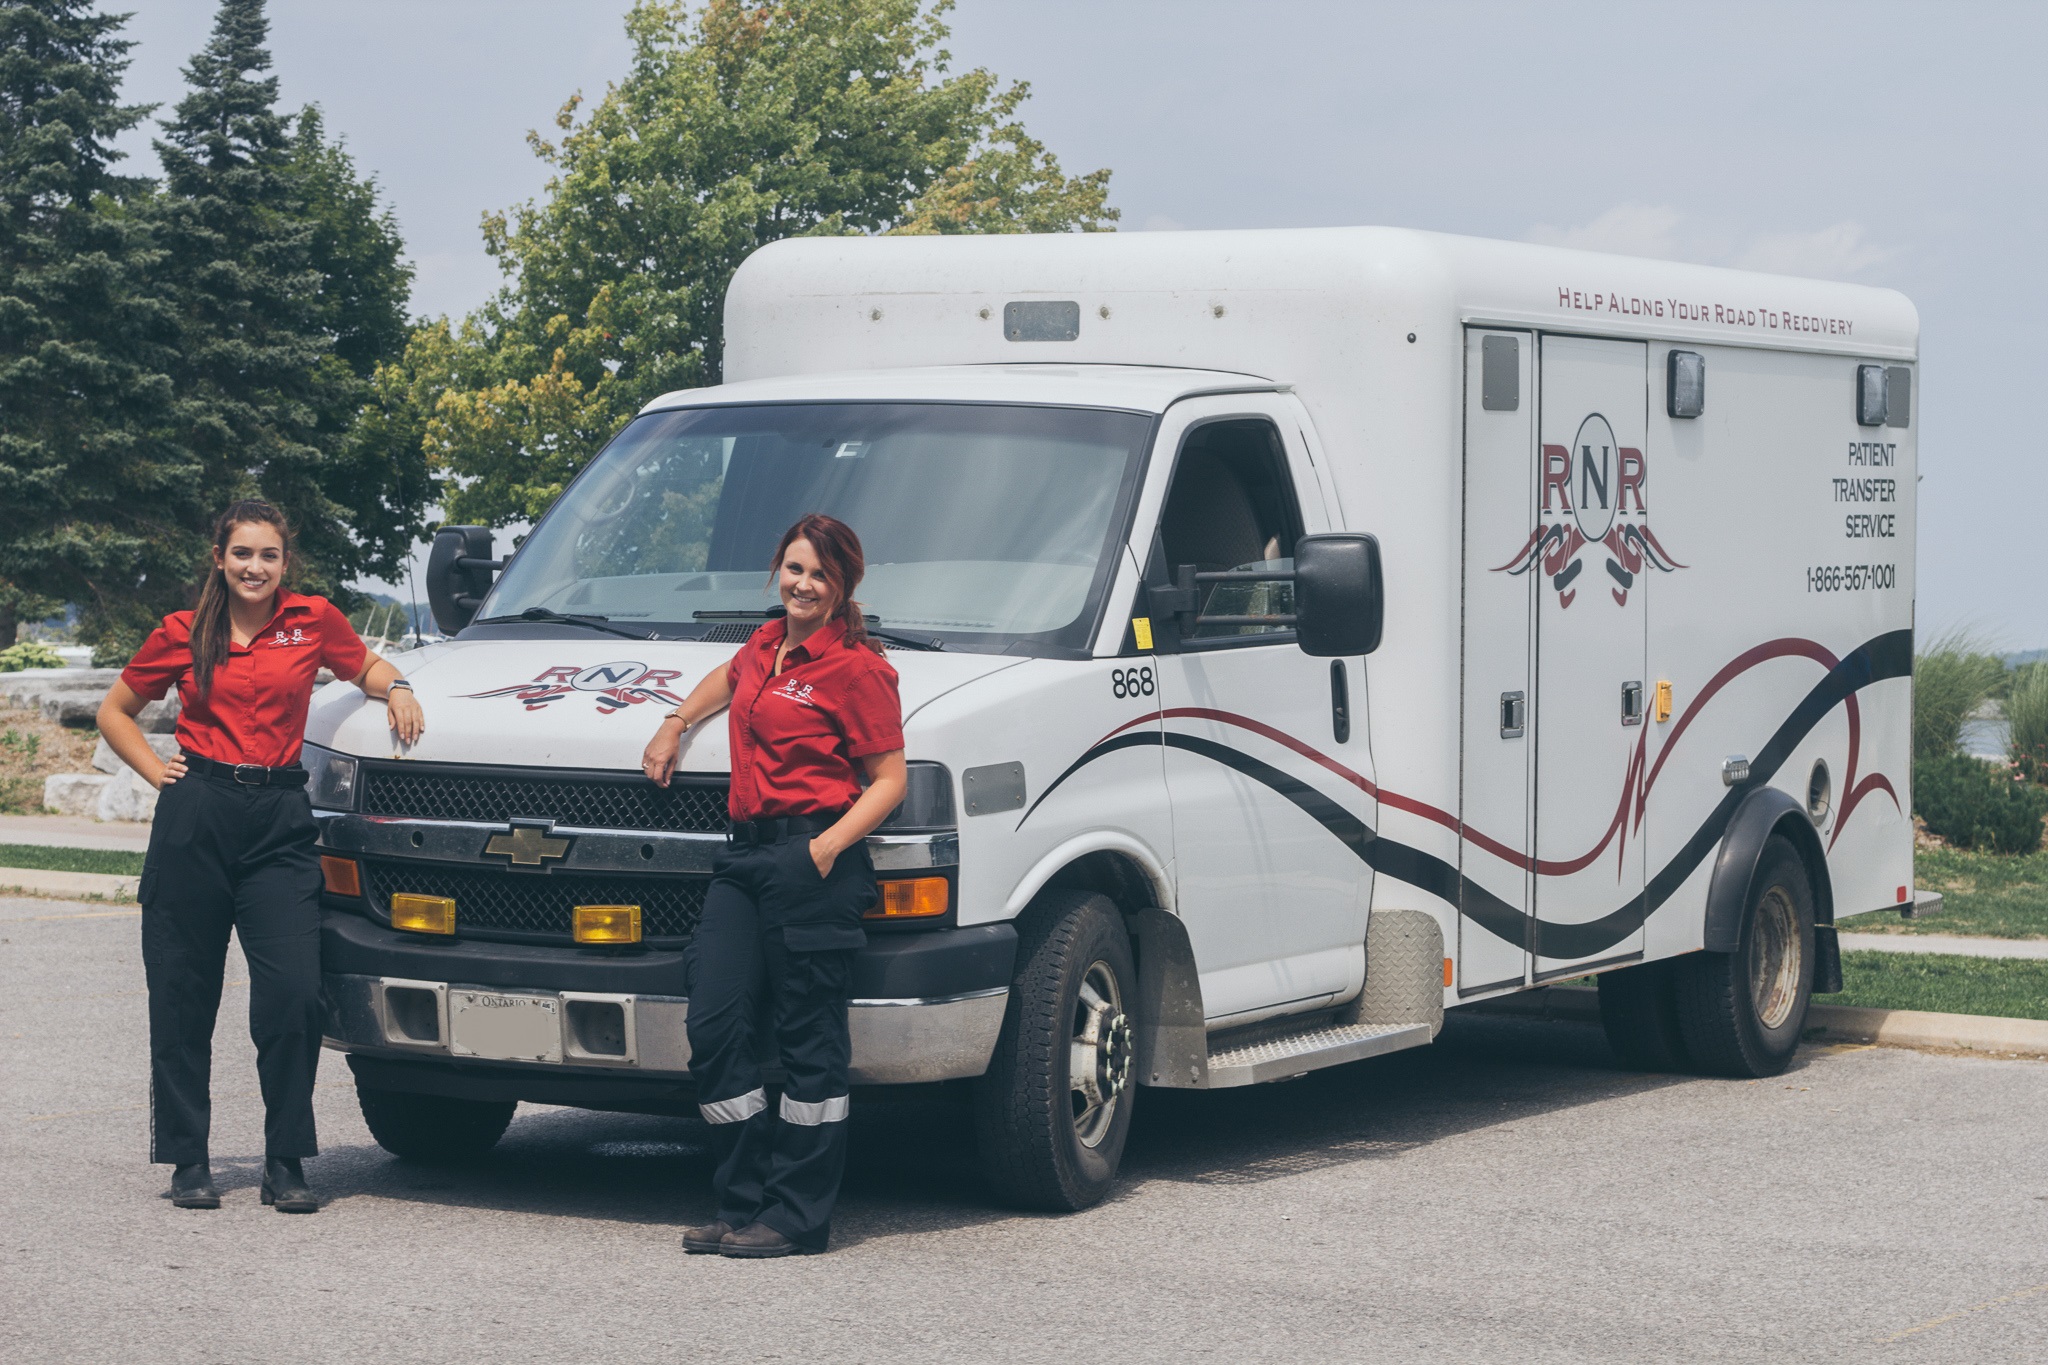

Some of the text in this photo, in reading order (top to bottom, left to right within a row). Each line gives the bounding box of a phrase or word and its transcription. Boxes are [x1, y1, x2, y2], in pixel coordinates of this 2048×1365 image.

[1558, 286, 1604, 311] HELP
[1608, 292, 1664, 317] ALONG
[1667, 298, 1710, 322] YOUR
[1714, 303, 1756, 327] ROAD
[1782, 310, 1853, 336] RECOVERY
[1848, 442, 1896, 467] PATIENT
[1541, 444, 1647, 515] RNR
[1832, 478, 1896, 502] TRANSFER
[1845, 514, 1896, 538] SERVICE
[1807, 564, 1895, 593] 1-866-567-1001
[532, 665, 683, 689] RNR
[1111, 666, 1155, 699] 868
